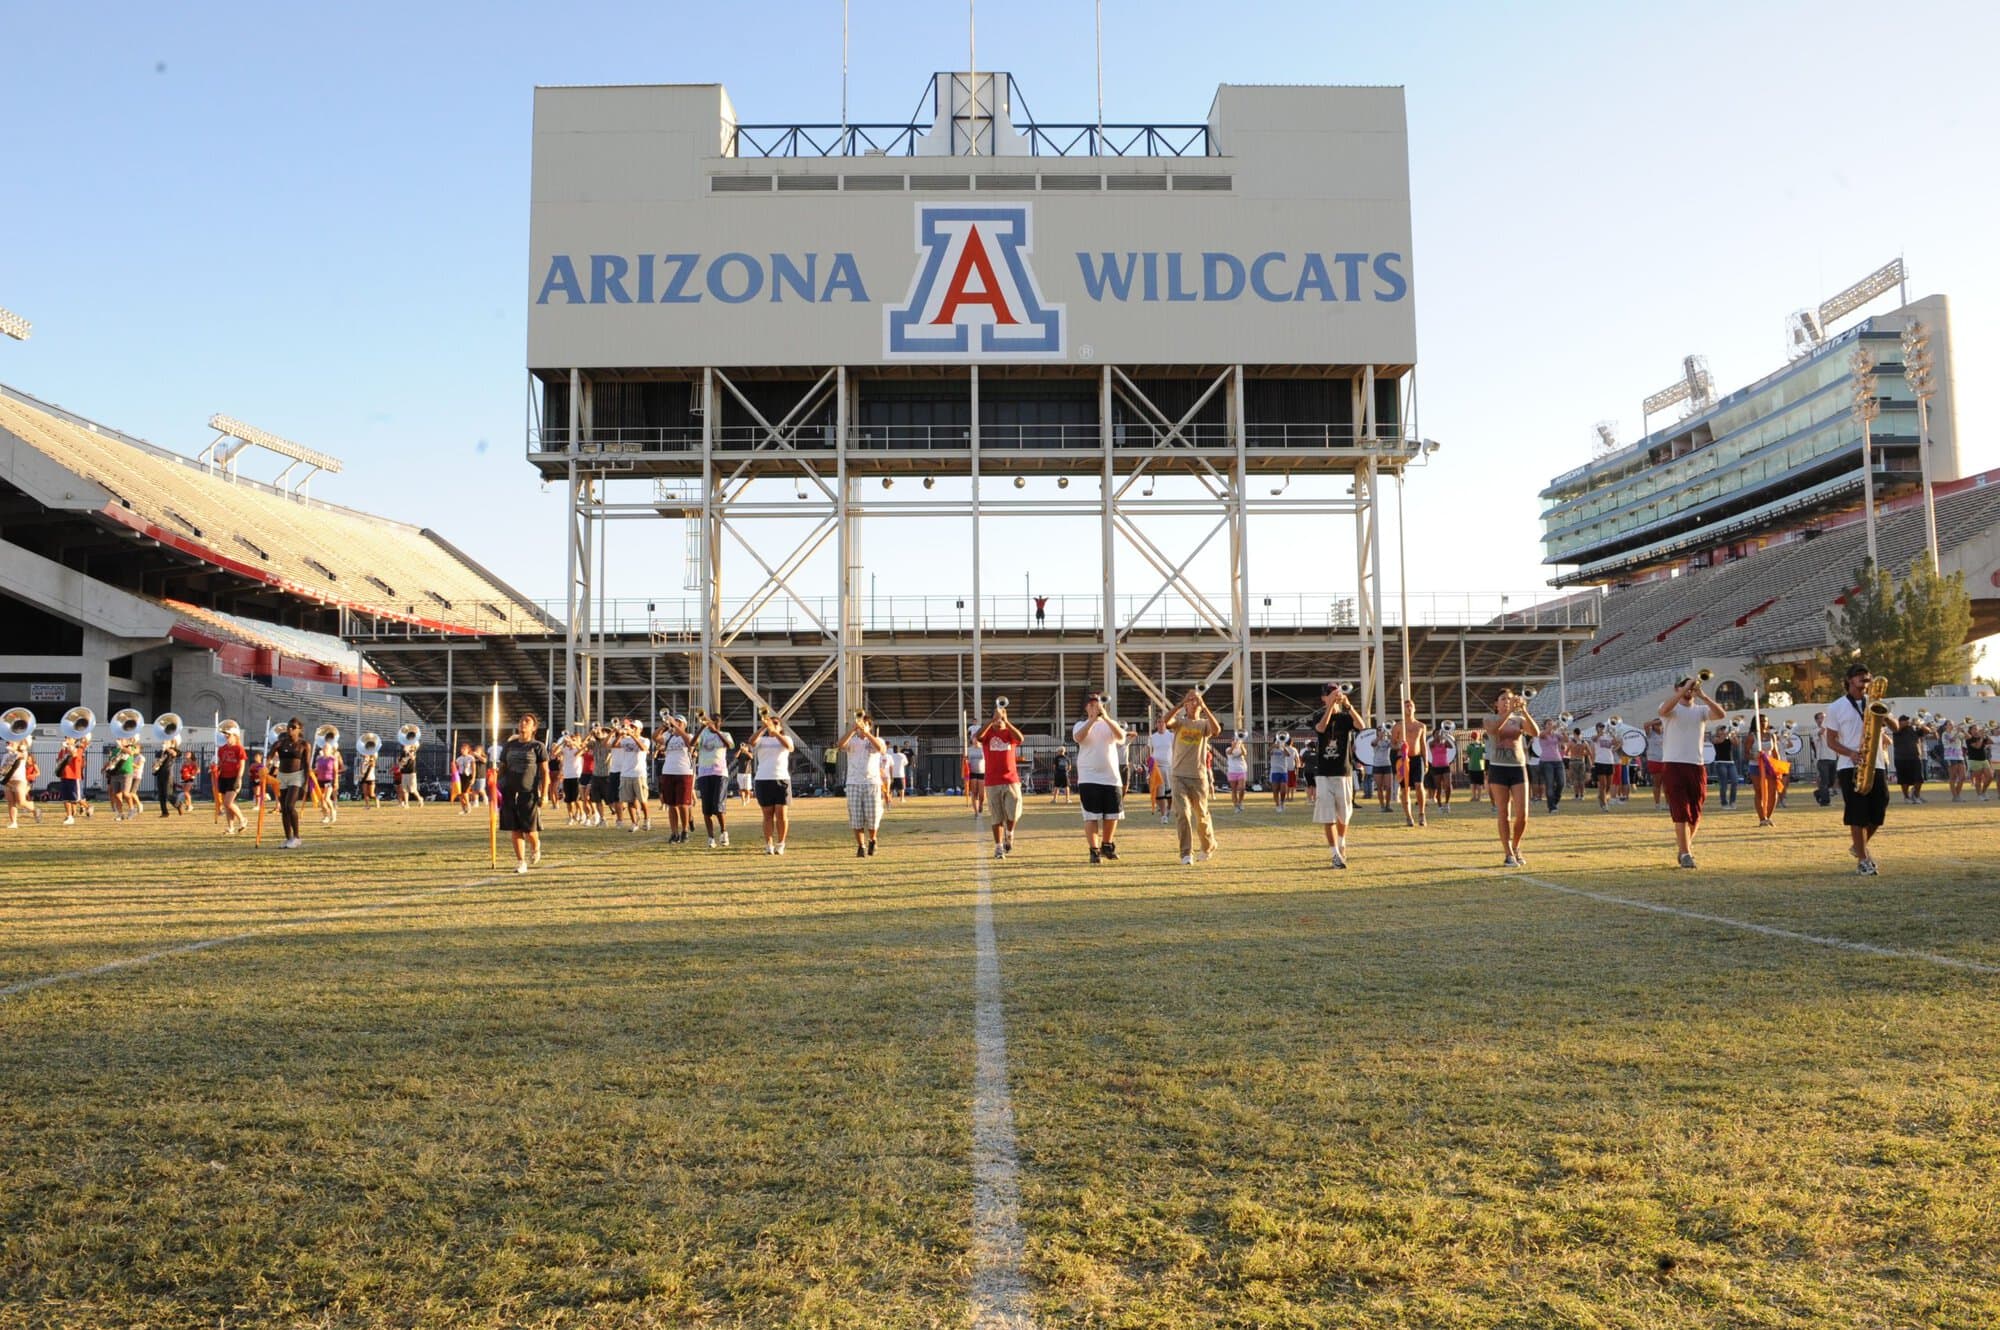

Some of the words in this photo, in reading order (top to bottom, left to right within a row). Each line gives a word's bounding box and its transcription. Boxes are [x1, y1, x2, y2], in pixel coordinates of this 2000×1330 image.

[536, 252, 871, 305] ARIZONA
[884, 203, 1065, 357] A
[1075, 251, 1408, 303] WILDCATS
